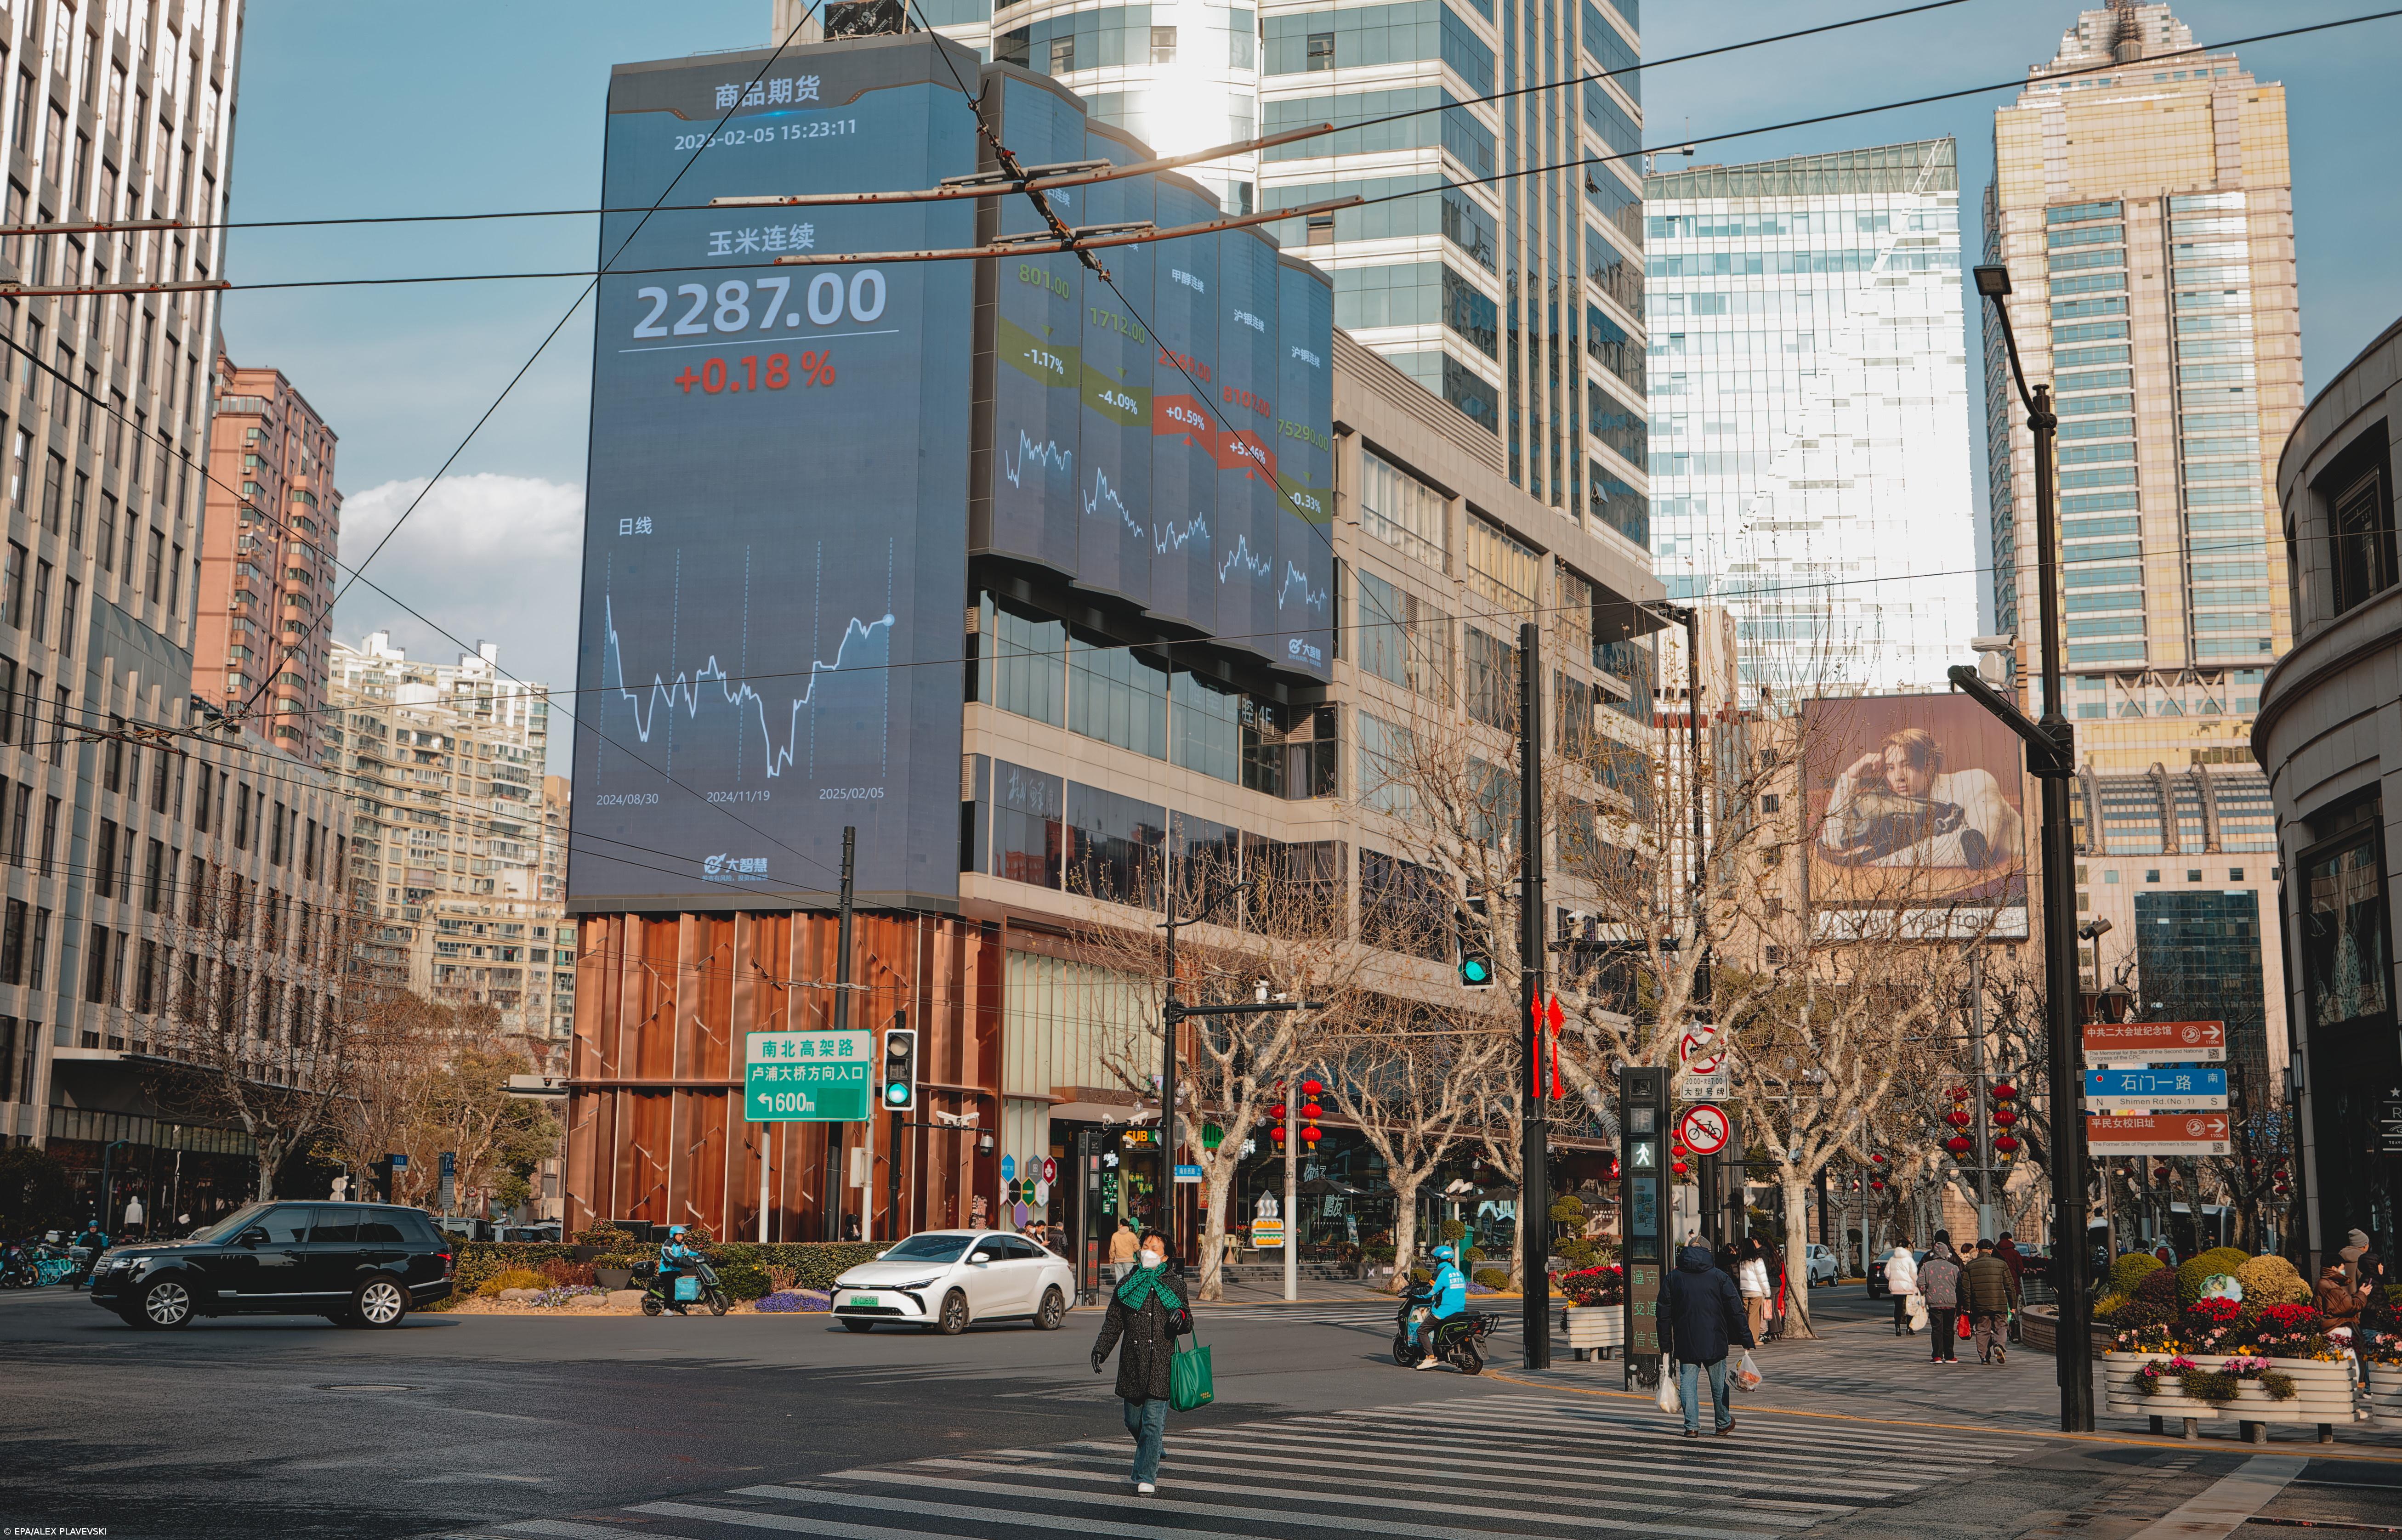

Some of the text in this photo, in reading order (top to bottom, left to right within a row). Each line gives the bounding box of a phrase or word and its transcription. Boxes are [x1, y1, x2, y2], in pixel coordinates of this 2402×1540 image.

[715, 75, 821, 110] 商品期货
[674, 119, 856, 151] 2025-02-05 15:23:11
[707, 222, 815, 257] 玉米连续
[1019, 264, 1069, 299] 801.00
[1172, 268, 1204, 294] 甲醇连续
[633, 269, 886, 339] 2287.00
[1090, 307, 1145, 344] 1712.00
[1234, 309, 1265, 333] 沪银连续
[1024, 349, 1063, 374] -1.17%
[1291, 345, 1320, 368] 沪铜连续
[1098, 390, 1137, 414] -4.09%
[1223, 385, 1271, 419] 8107.00
[1166, 406, 1205, 430] +0.59%
[1278, 419, 1329, 452] 75290.00
[1289, 491, 1321, 513] -0.33%
[619, 516, 653, 536] 日线
[1302, 644, 1321, 661] 大智慧
[596, 793, 659, 806] 2024/08/30
[707, 790, 770, 804] 2024/11/19
[819, 787, 884, 800] 2025/02/05
[726, 858, 767, 873] 大智慧
[2087, 1026, 2172, 1038] 中共二大会址纪念馆
[762, 1039, 854, 1058] 南北高架路
[751, 1066, 863, 1081] 卢浦大桥方向入口
[2121, 1073, 2218, 1091] 石门一路 南
[1684, 1088, 1725, 1096] 大型号牌
[776, 1093, 814, 1112] 600m
[2091, 1118, 2155, 1128] 平民女校旧址
[1633, 1269, 1658, 1285] 遵守
[1634, 1301, 1657, 1316] 交通
[1634, 1331, 1658, 1348] 信号
